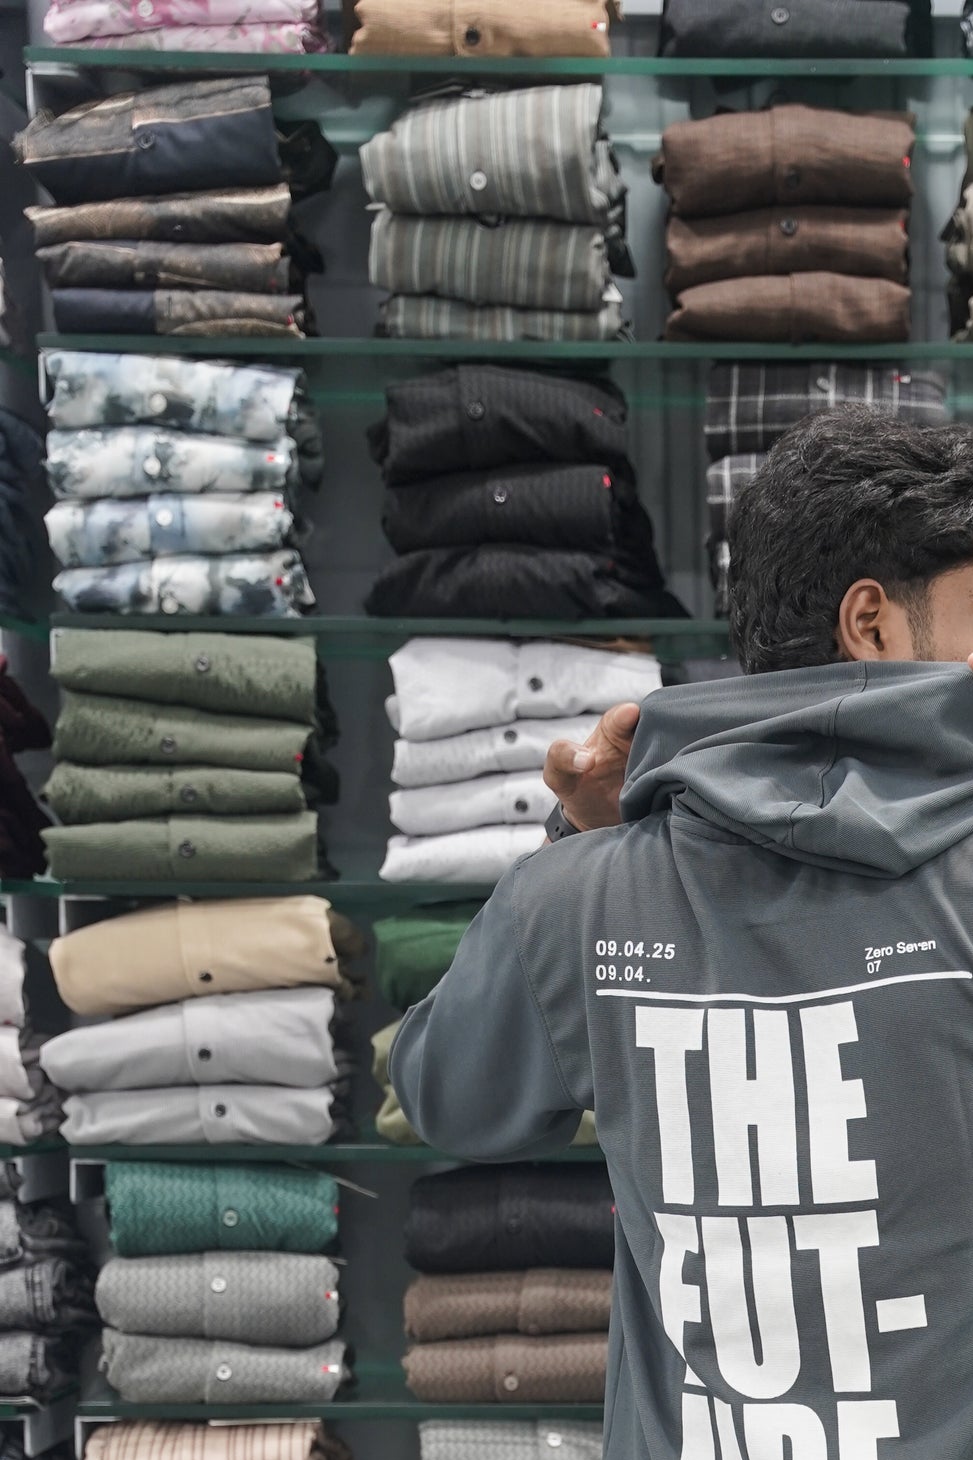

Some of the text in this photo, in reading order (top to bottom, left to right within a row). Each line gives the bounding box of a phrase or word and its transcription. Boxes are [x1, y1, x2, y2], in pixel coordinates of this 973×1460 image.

[595, 940, 676, 960] 09.04.25
[864, 939, 937, 960] Zero Seven
[595, 964, 652, 983] 09.04.
[866, 959, 882, 974] 07
[634, 1000, 880, 1207] THE
[652, 1209, 929, 1400] FUT-
